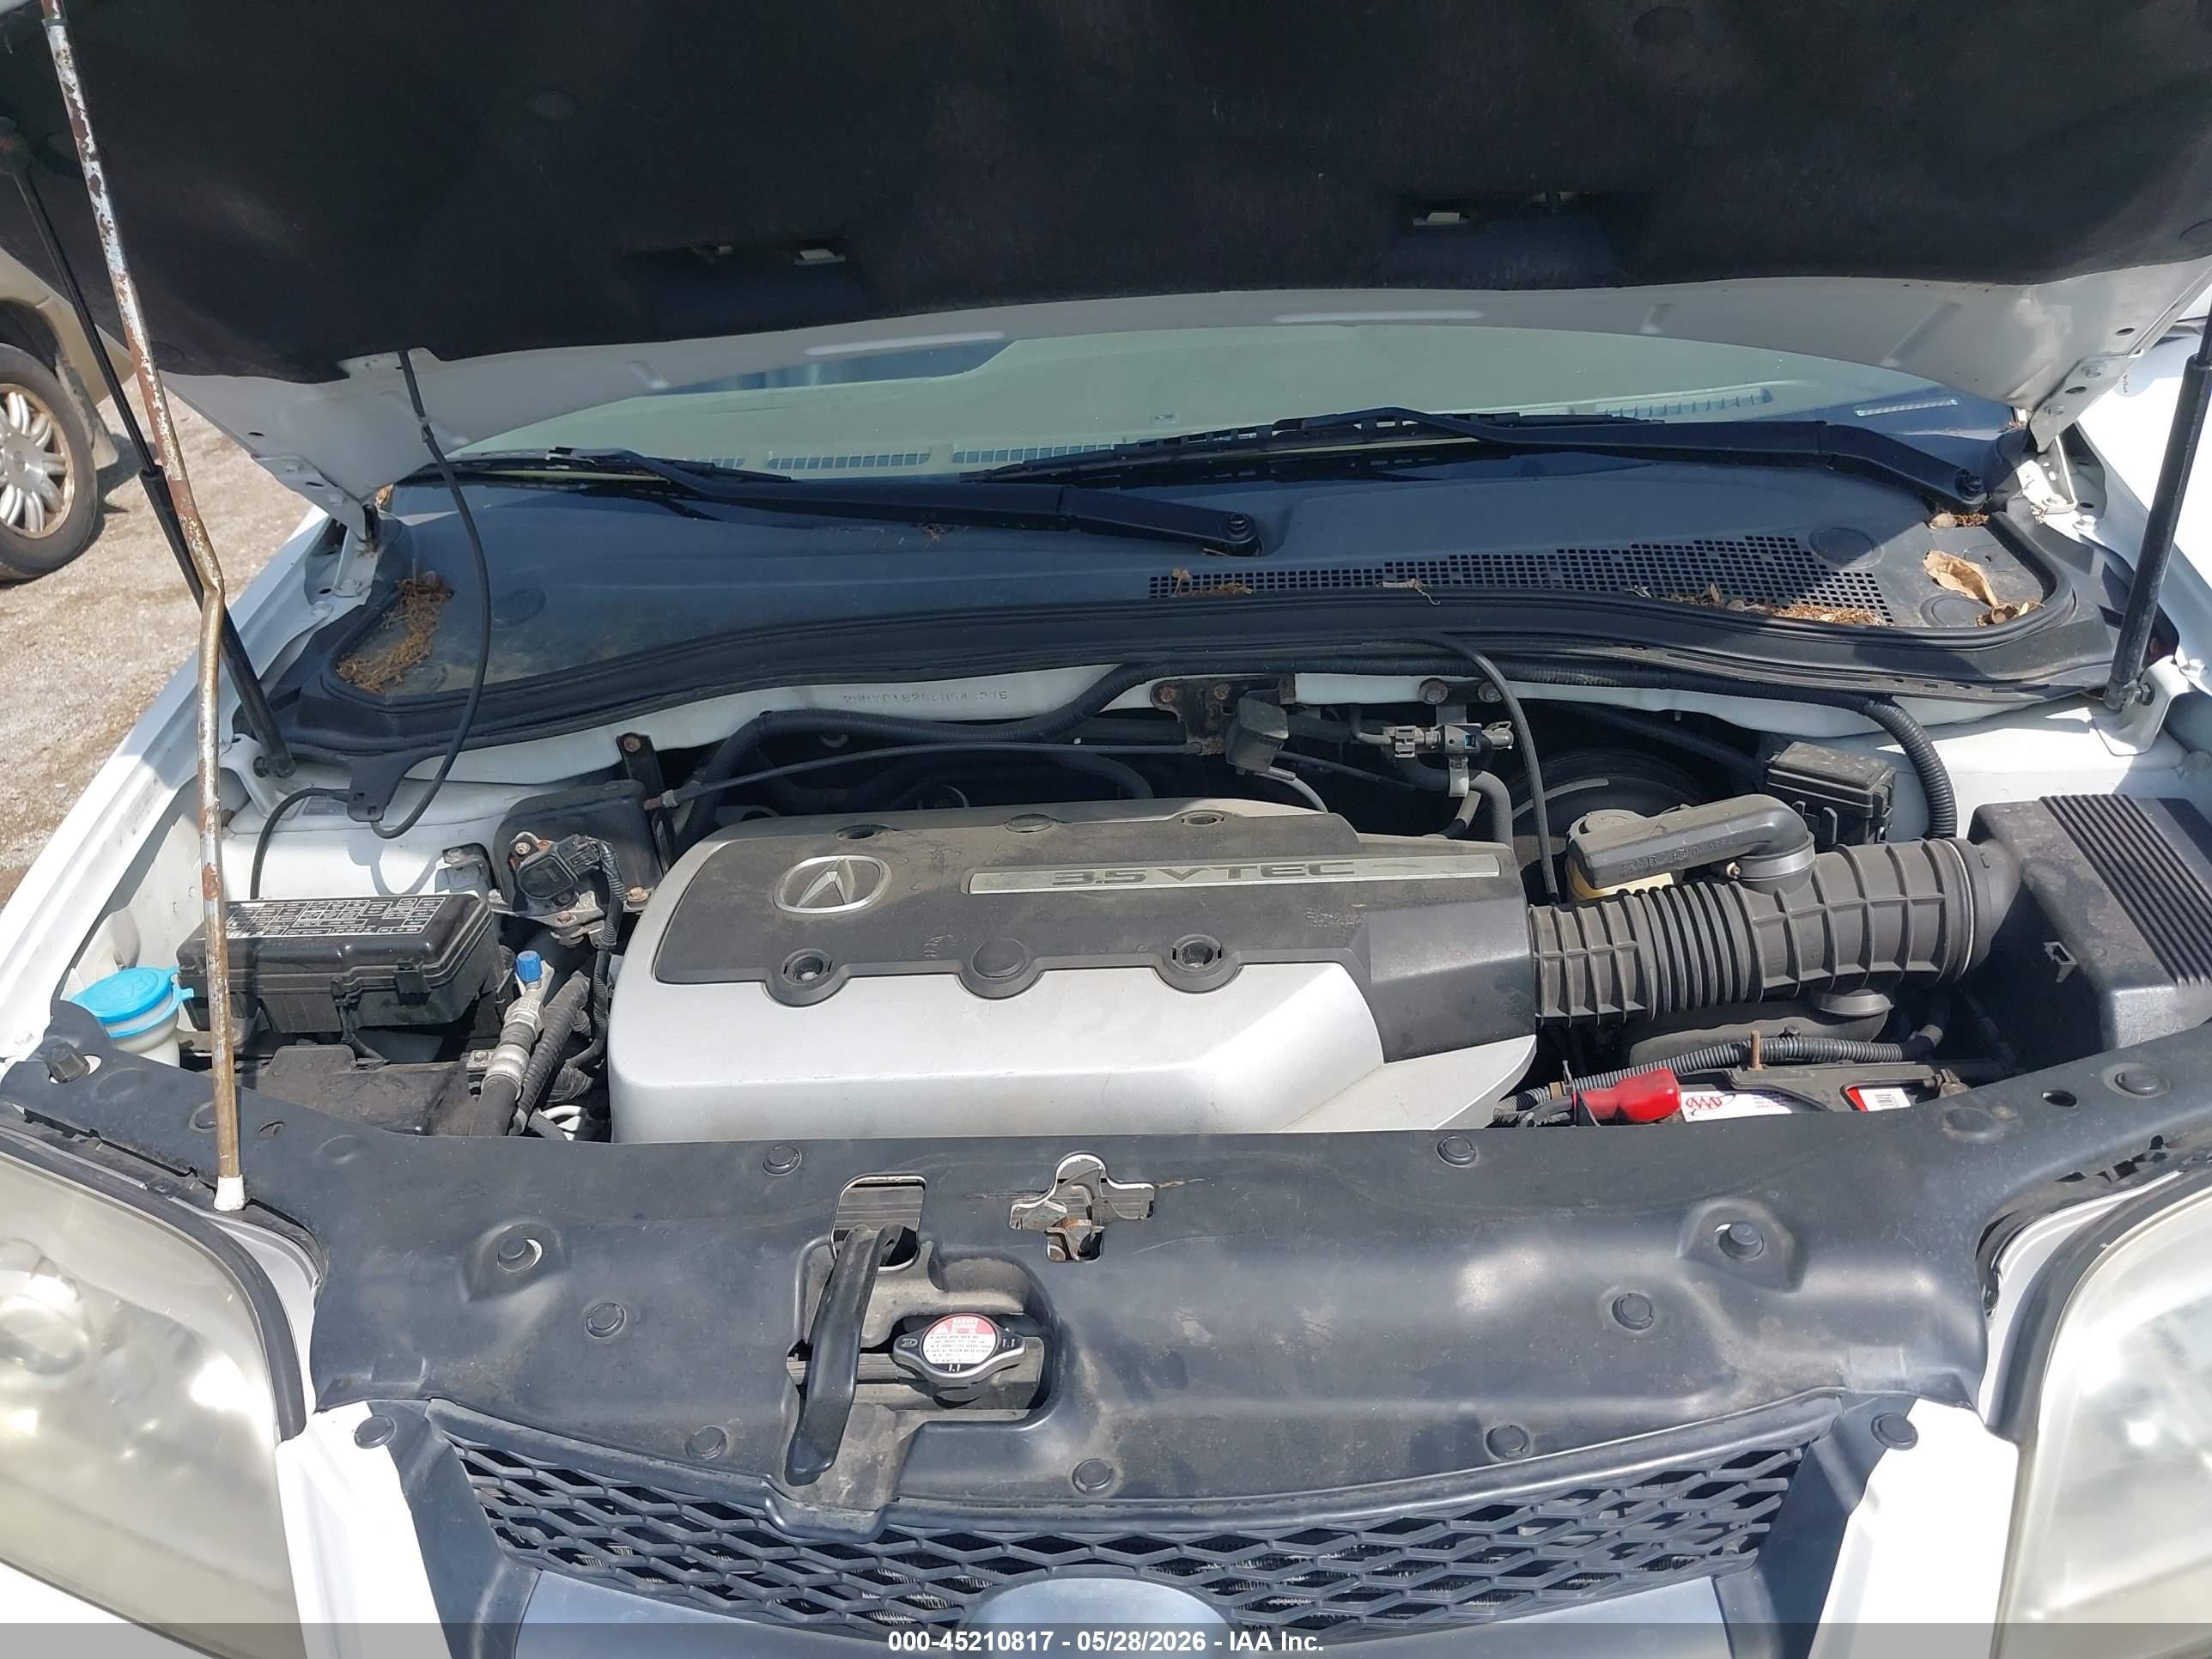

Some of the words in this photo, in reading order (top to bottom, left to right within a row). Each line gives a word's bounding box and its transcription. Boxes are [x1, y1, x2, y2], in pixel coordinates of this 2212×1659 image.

[1052, 869, 1147, 886] 3.5
[1158, 861, 1355, 881] VTEC
[948, 1364, 961, 1372] 1.1
